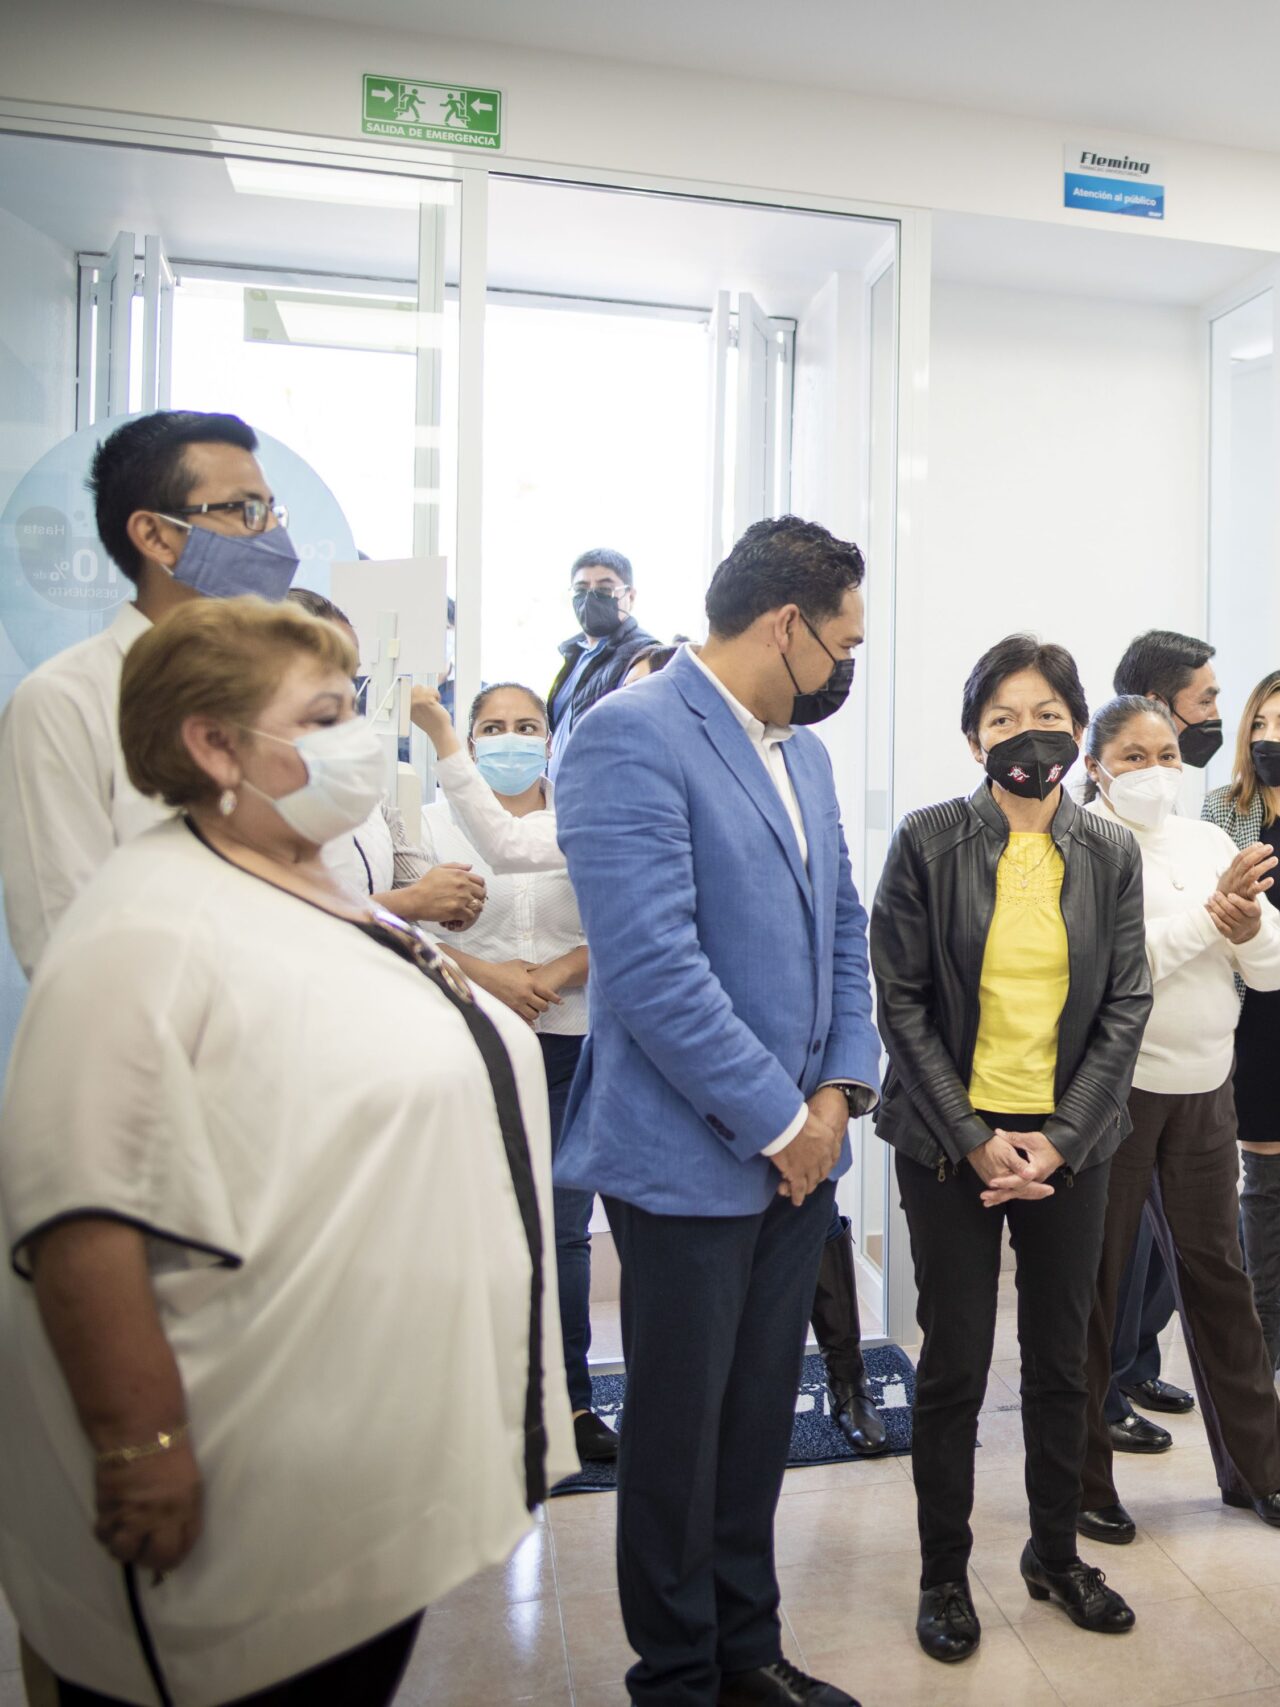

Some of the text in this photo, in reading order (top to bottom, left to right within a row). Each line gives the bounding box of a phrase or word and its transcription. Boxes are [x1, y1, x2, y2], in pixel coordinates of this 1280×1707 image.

[366, 122, 496, 146] SALIDA DE EMERGENCIA
[1080, 151, 1150, 175] Fleming
[1073, 187, 1157, 207] Atención al público
